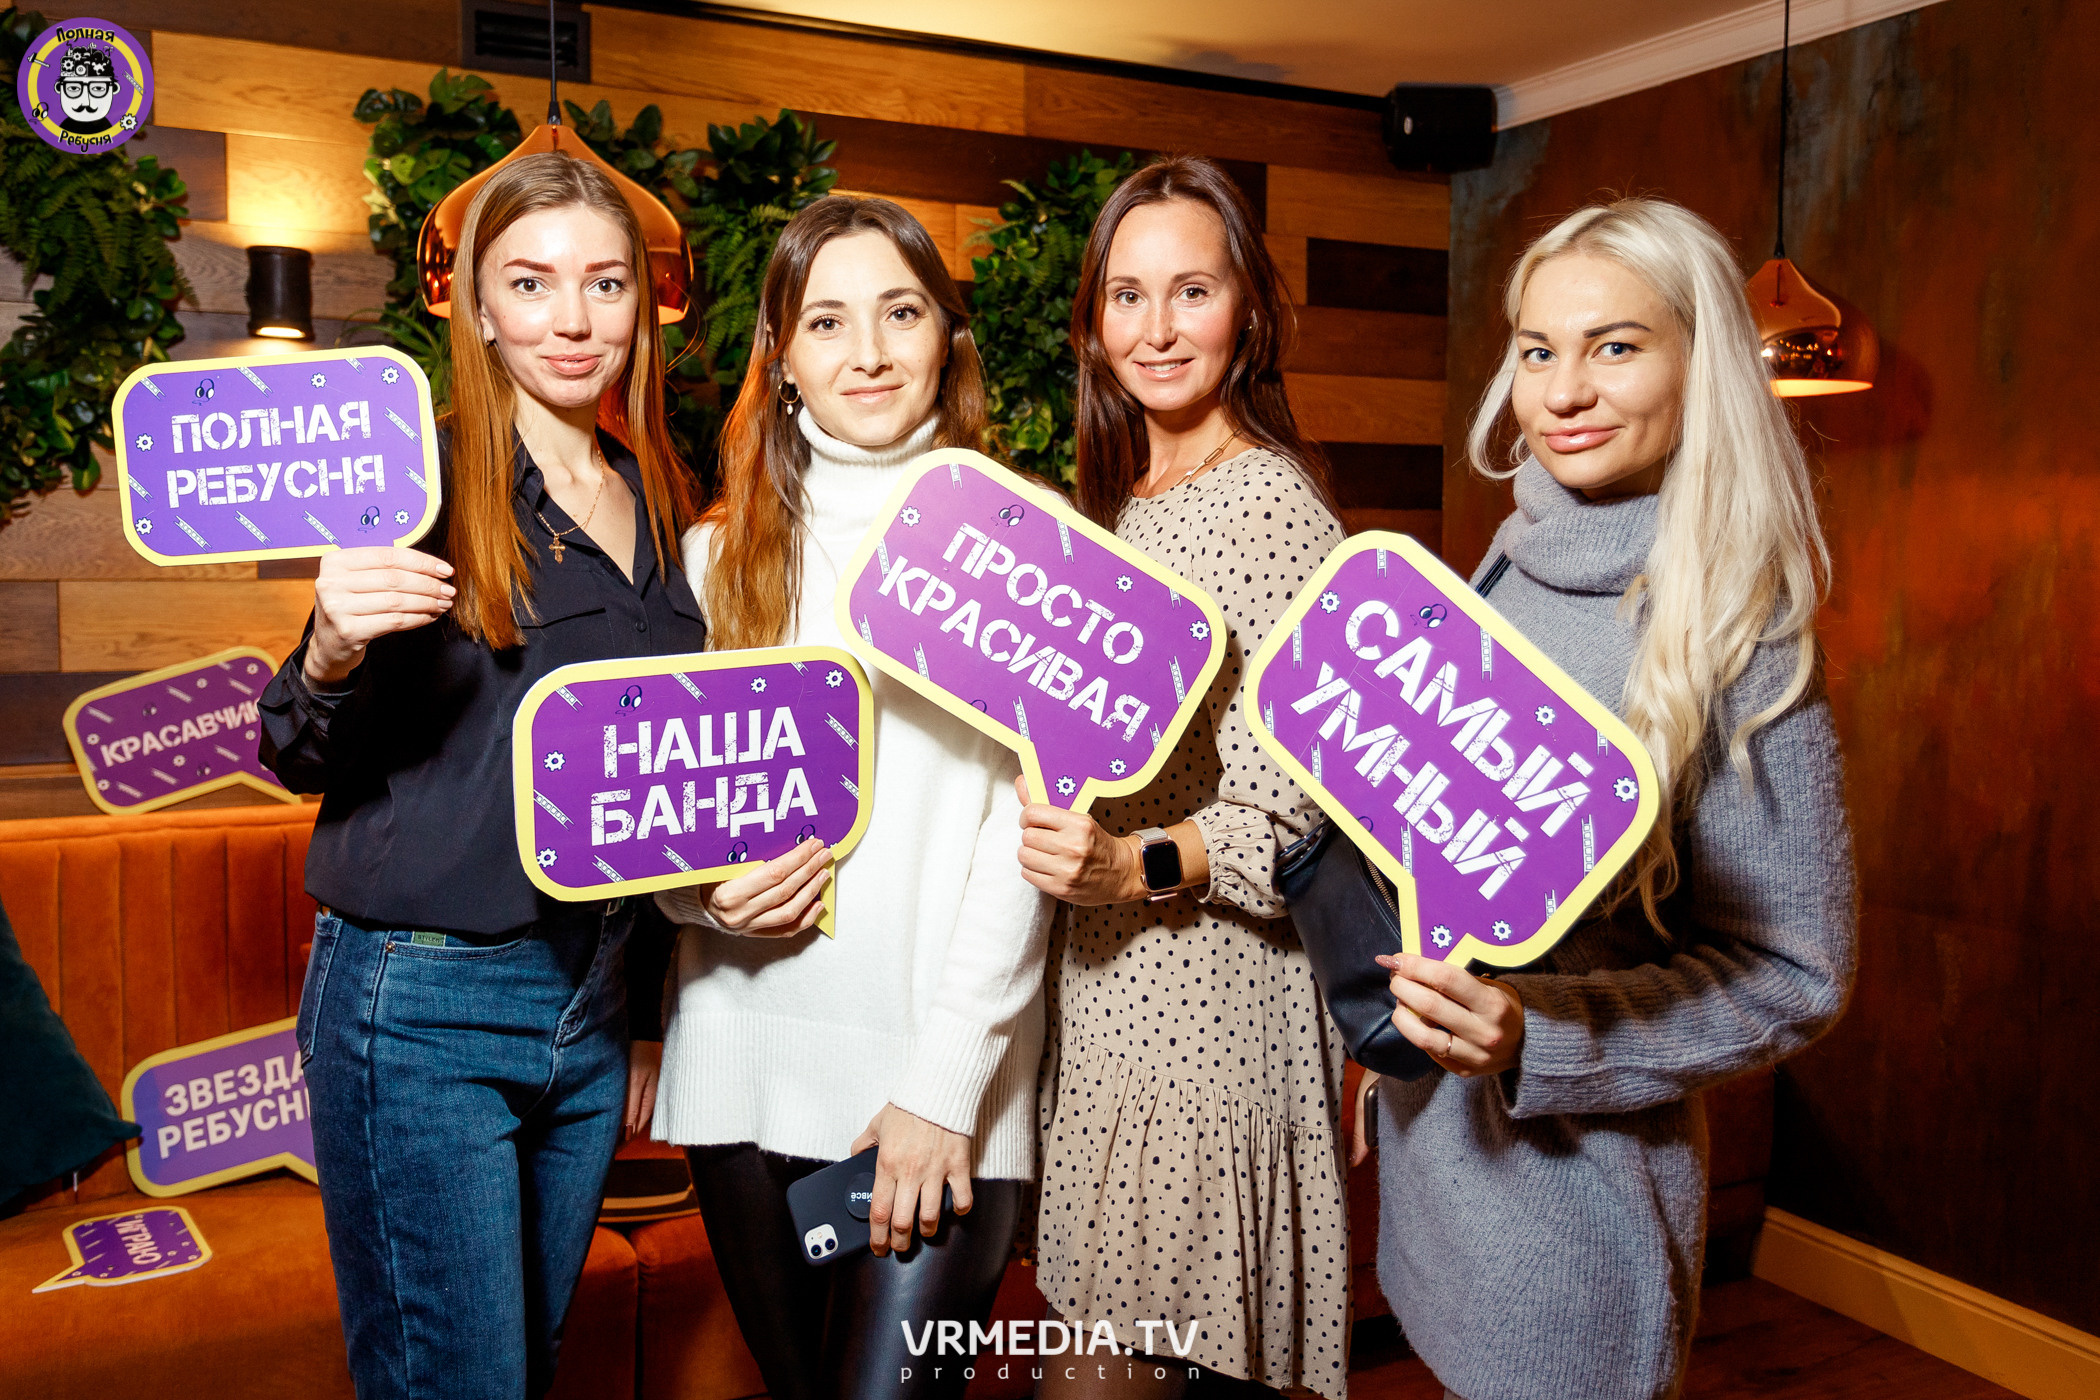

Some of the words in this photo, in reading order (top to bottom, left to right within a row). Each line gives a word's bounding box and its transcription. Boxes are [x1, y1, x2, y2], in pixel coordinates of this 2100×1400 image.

[171, 401, 371, 453] ПОЛНАЯ
[166, 454, 386, 508] РЕБУСНЯ
[942, 522, 1144, 665] ПРОСТО
[877, 555, 1151, 742] КРАСИВАЯ
[603, 706, 806, 778] НАША
[1345, 600, 1594, 838] САМЫЙ
[591, 767, 818, 846] БАНДА
[1290, 661, 1527, 900] УМНЫЙ
[157, 1087, 310, 1159] РЕБУСН
[851, 1192, 873, 1202] йвсё
[115, 1219, 162, 1265] ИГРАЮ
